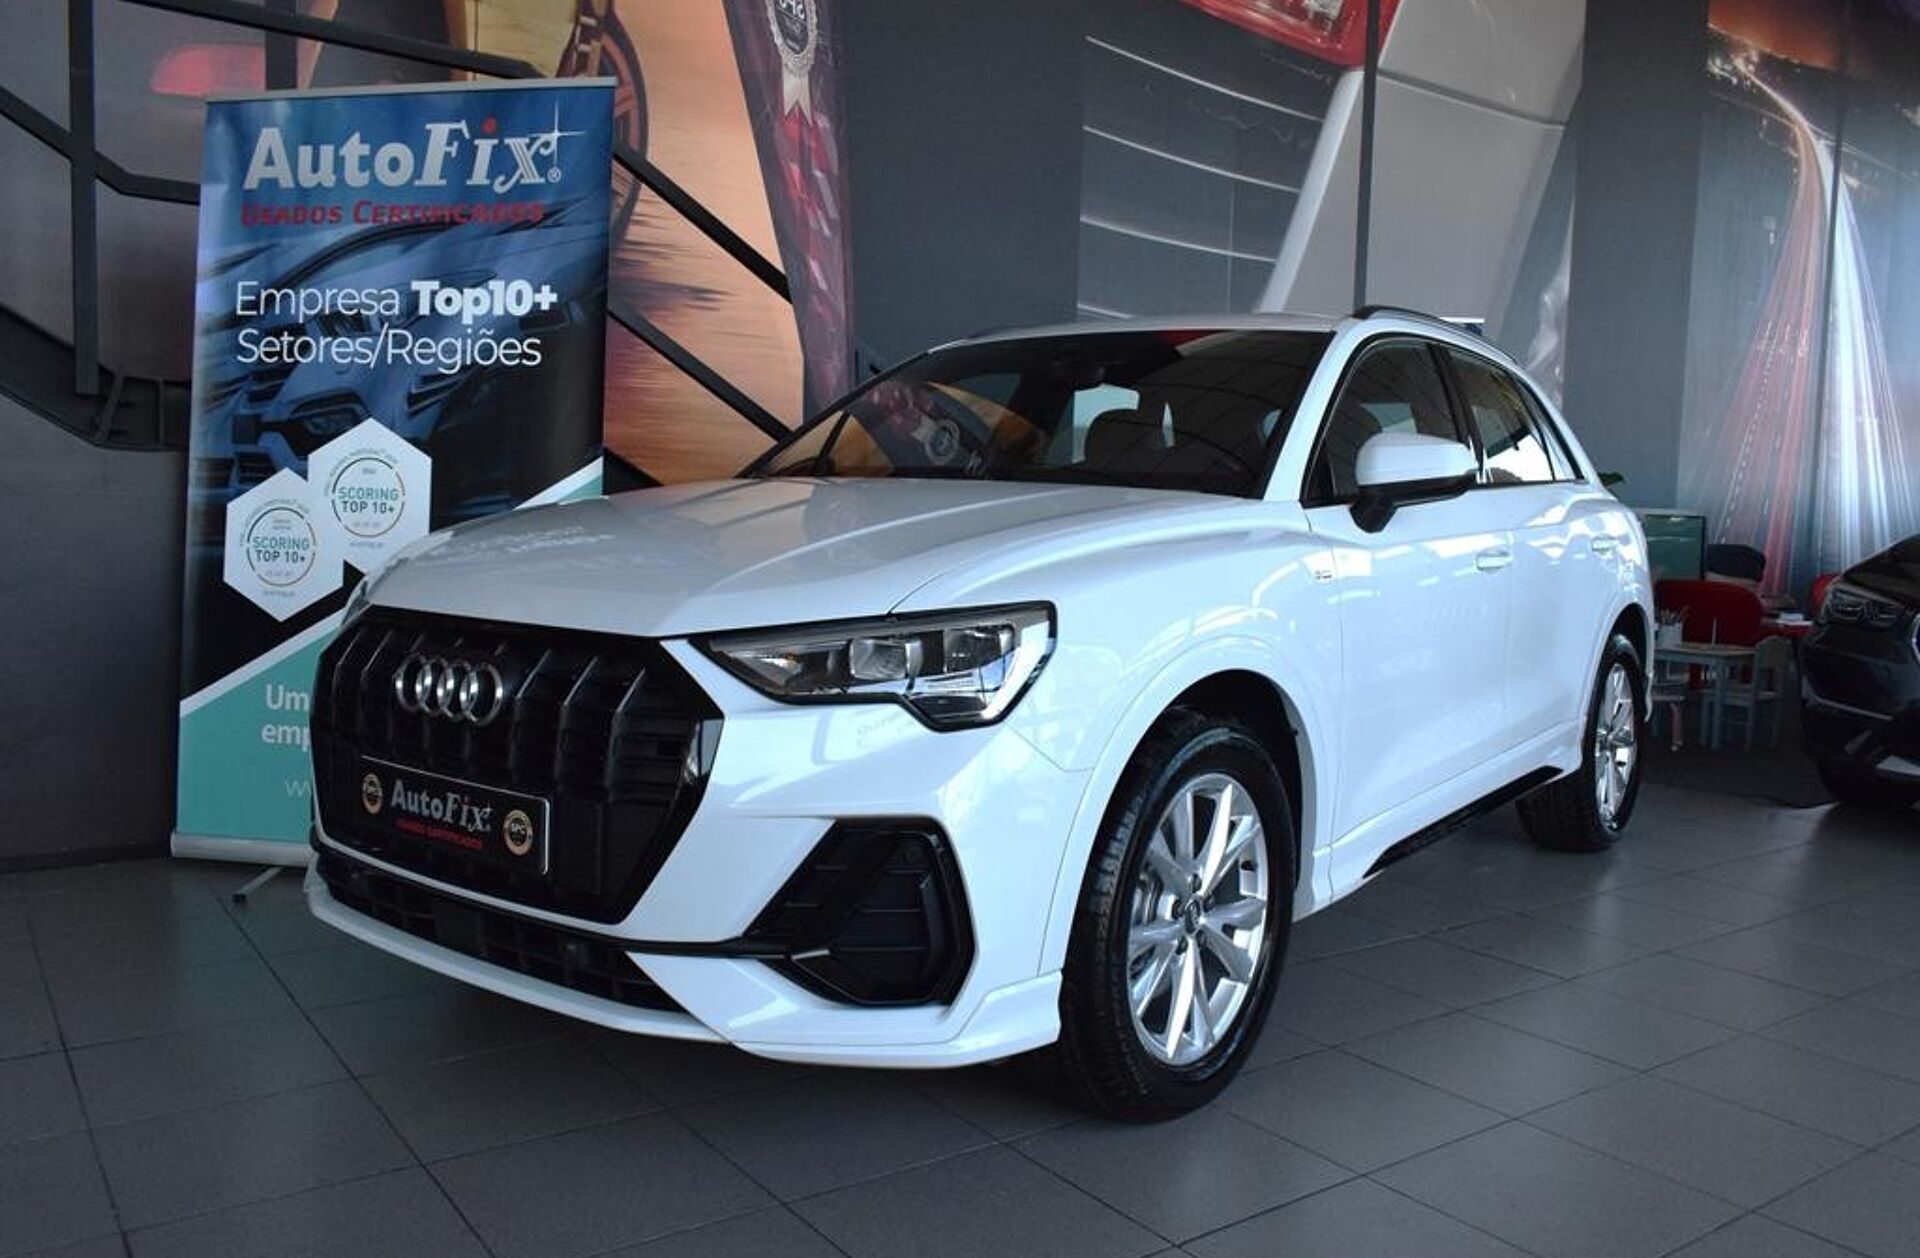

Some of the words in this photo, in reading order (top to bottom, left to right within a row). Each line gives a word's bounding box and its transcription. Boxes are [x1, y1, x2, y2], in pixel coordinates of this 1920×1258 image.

[236, 281, 400, 325] Empresa
[411, 280, 558, 325] Top10+
[237, 323, 542, 374] Setores/Regiões
[338, 487, 399, 501] SCORING
[341, 500, 368, 513] TOP
[372, 501, 395, 514] 10+
[253, 536, 310, 551] SCORING
[255, 549, 280, 562] TOP
[266, 684, 310, 711] Um
